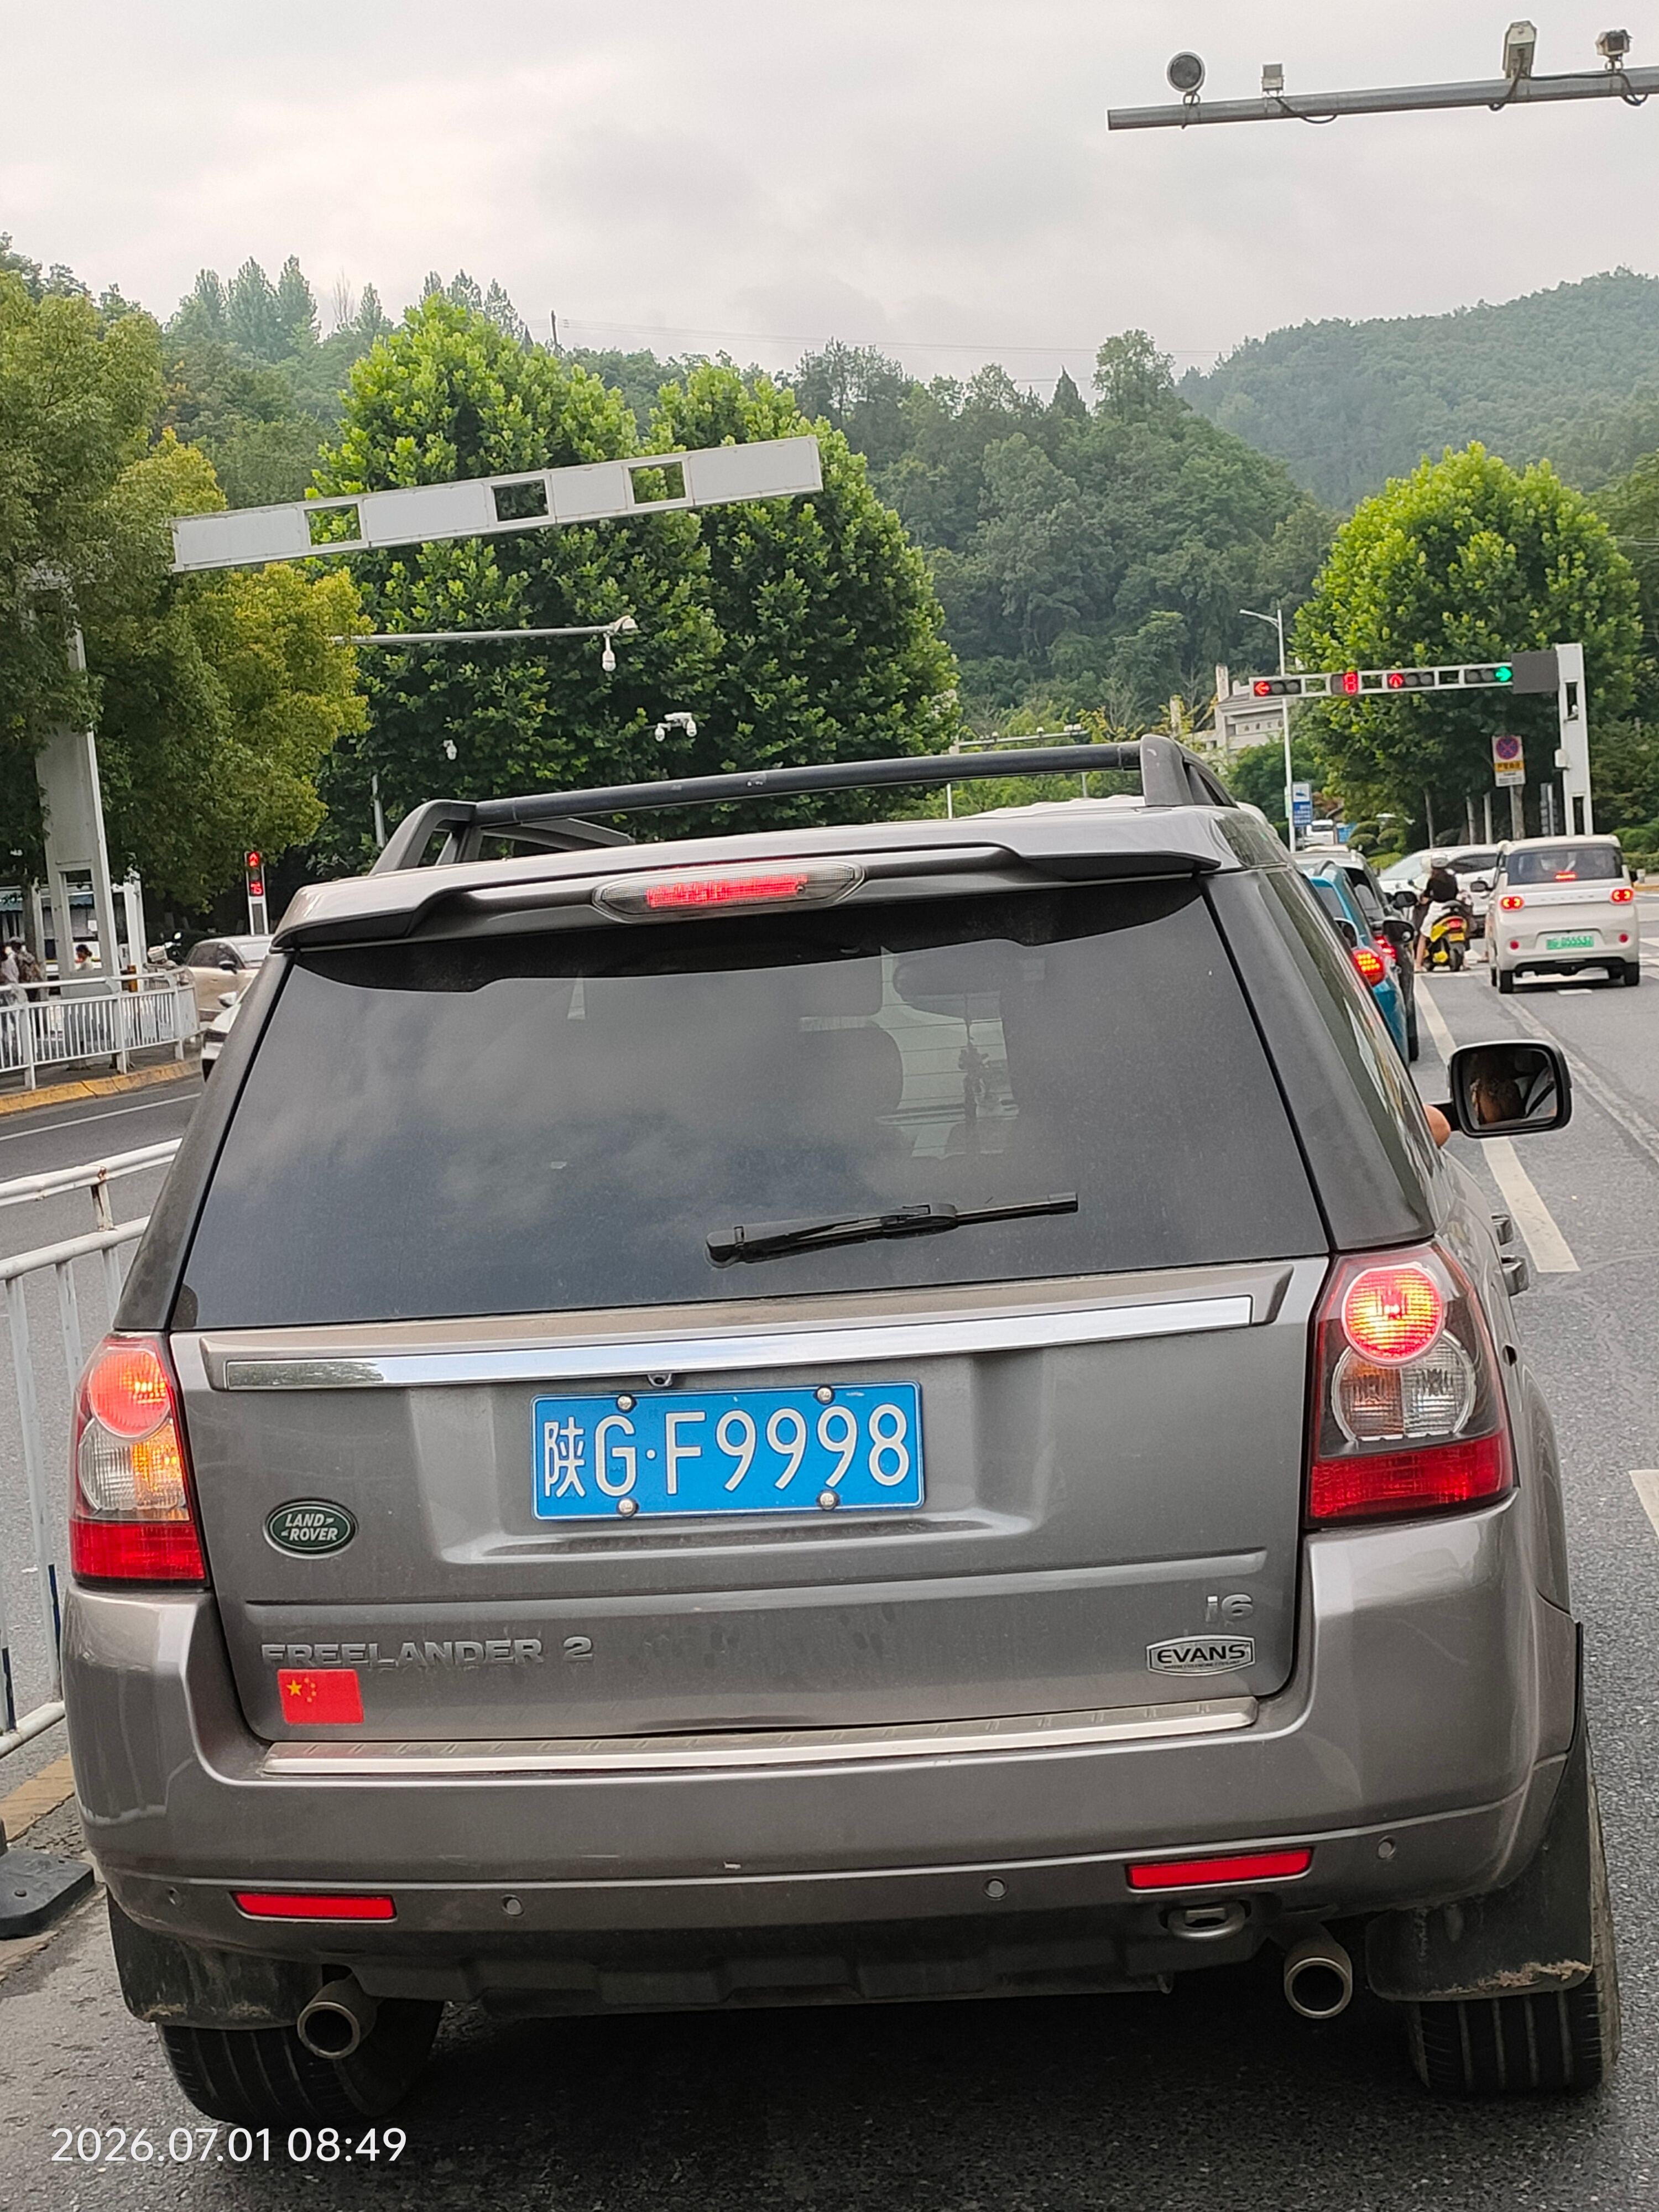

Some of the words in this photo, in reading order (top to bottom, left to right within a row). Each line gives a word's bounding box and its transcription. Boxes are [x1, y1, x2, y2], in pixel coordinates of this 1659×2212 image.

[544, 1403, 910, 1498] 陕G·F9998
[285, 1513, 325, 1527] LAND
[289, 1527, 338, 1541] ROVER
[1205, 1593, 1254, 1623] i6
[261, 1638, 544, 1668] FREELANDER
[562, 1635, 594, 1662] 2
[1157, 1644, 1245, 1663] EVANS
